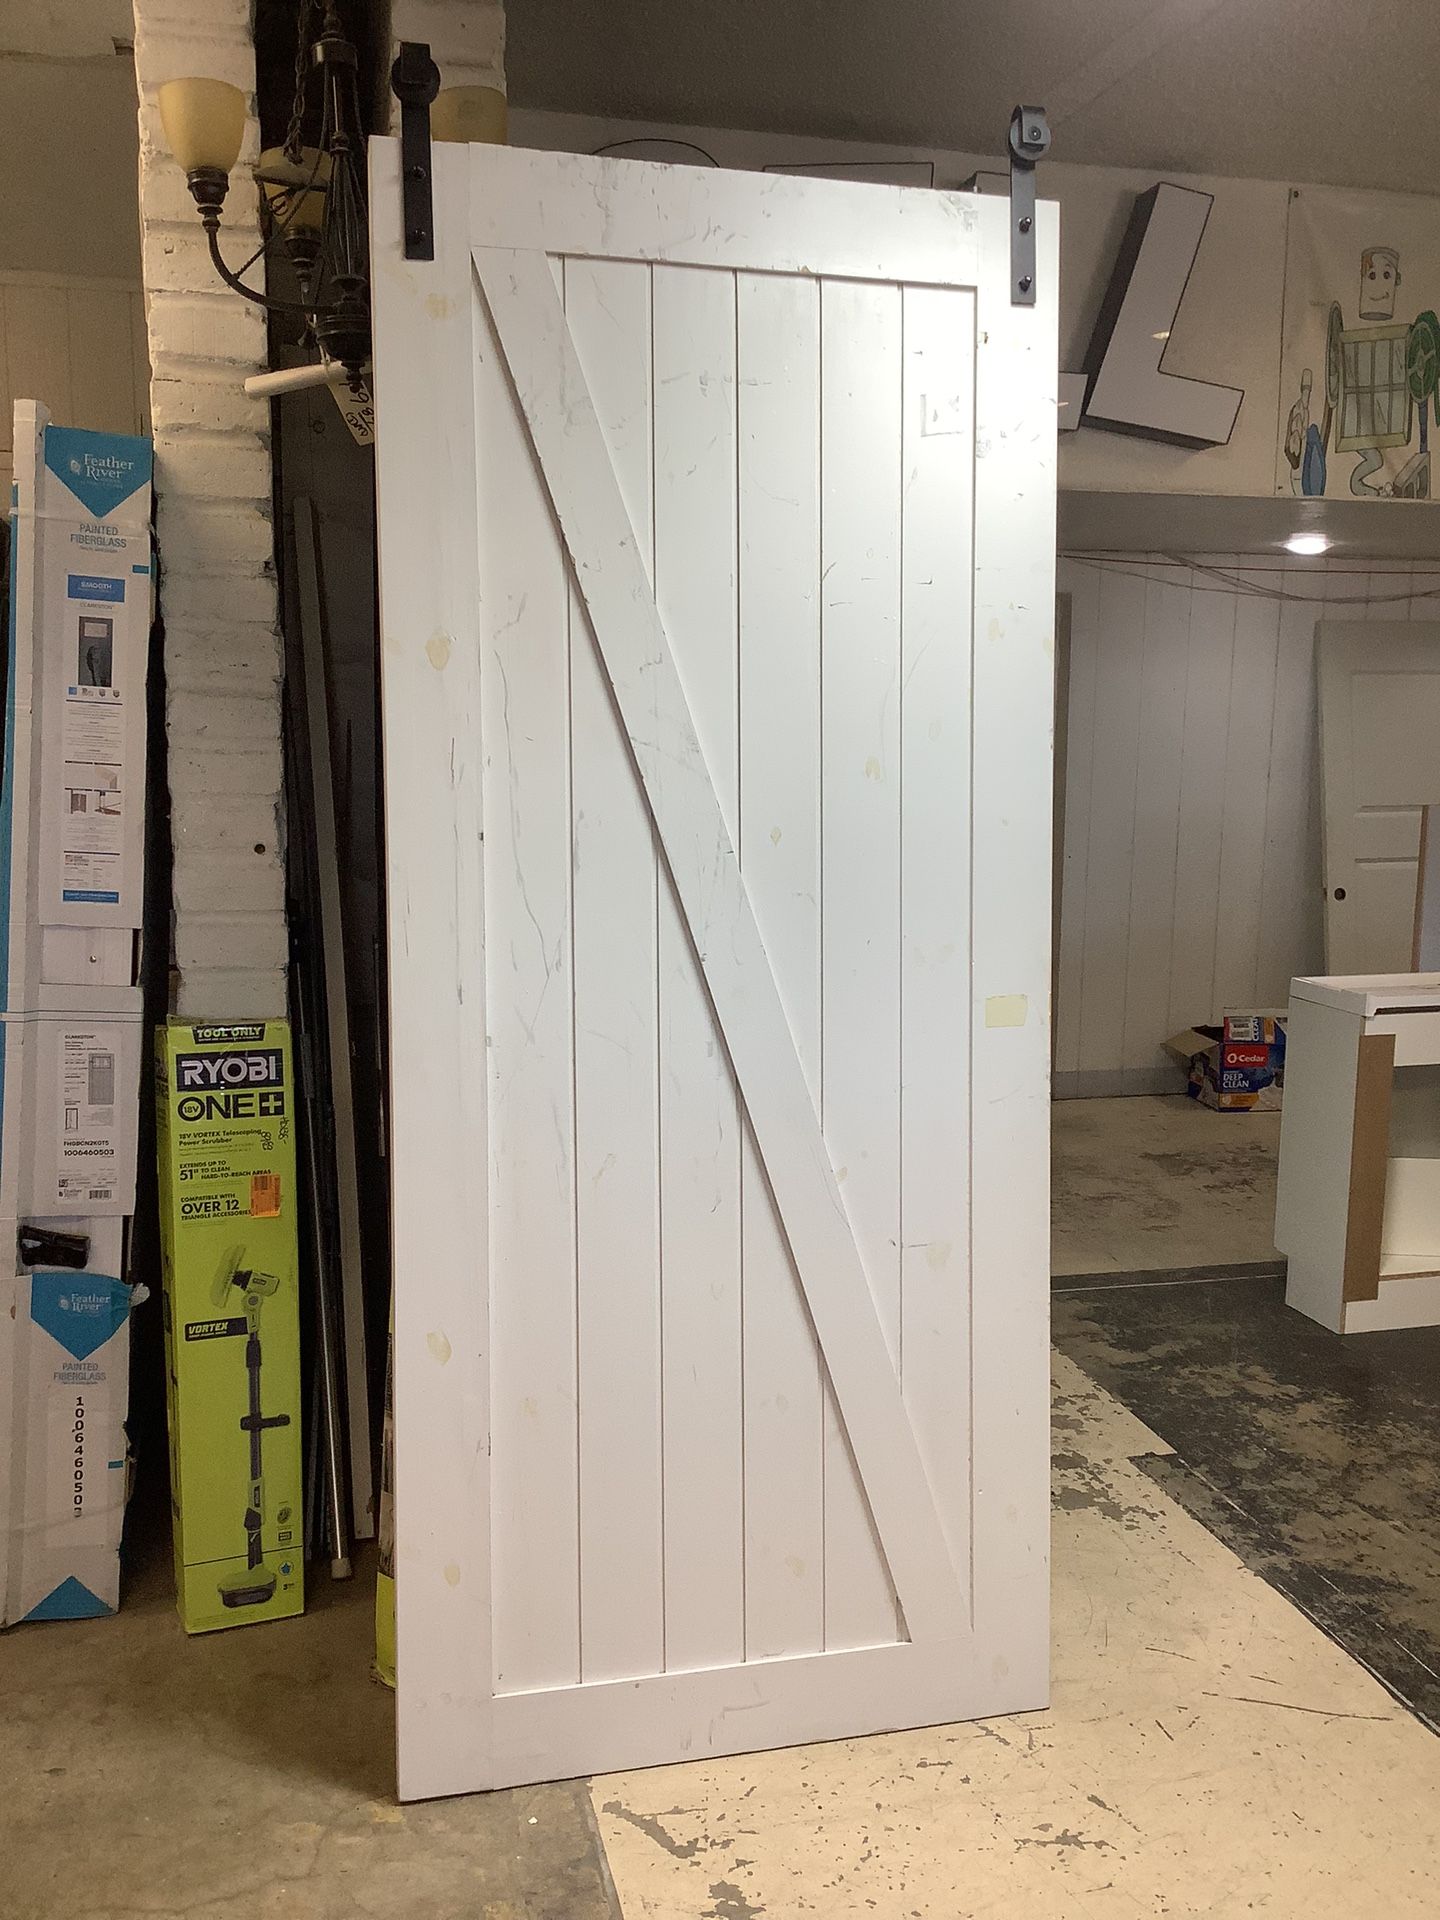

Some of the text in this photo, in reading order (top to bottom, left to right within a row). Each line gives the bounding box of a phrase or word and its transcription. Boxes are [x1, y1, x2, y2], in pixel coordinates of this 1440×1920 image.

[84, 453, 134, 470] Feather
[86, 465, 124, 481] River
[80, 523, 118, 536] PAINTED
[70, 533, 127, 548] FIBERGLASS
[197, 1027, 262, 1038] TOOL ONLY
[181, 1055, 276, 1086] RYOBI
[1223, 1073, 1243, 1081] DEEP
[1222, 1080, 1249, 1089] CLEAN
[181, 1195, 218, 1203] COMPATIBLE
[181, 1199, 239, 1215] OVER 12
[71, 1293, 111, 1304] Feather
[72, 1302, 100, 1312] River
[189, 1322, 229, 1335] VORTEX
[62, 1362, 99, 1371] PAINTED
[53, 1371, 107, 1381] FIBERGLASS
